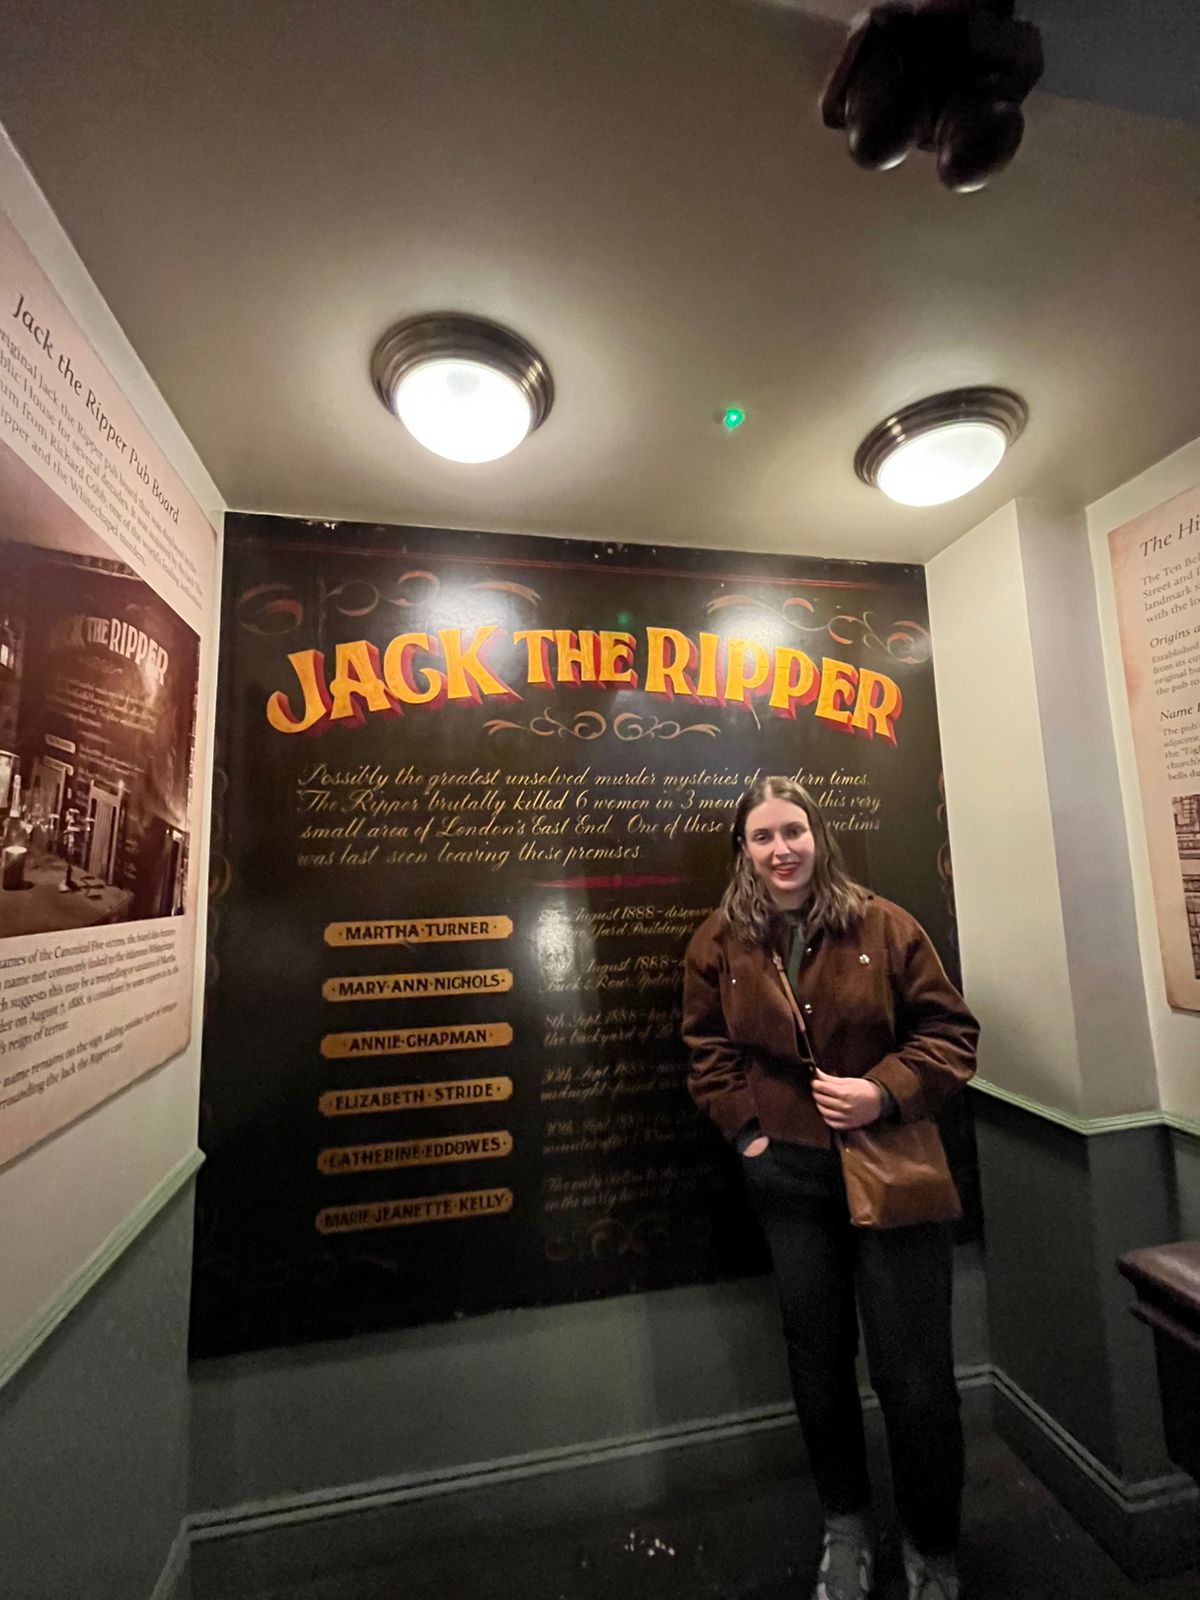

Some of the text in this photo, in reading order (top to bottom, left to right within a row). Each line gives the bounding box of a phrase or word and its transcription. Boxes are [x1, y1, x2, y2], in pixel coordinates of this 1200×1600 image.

[13, 292, 180, 525] Jack the Ripper Pub Board
[23, 378, 56, 426] House
[57, 420, 72, 444] for
[39, 374, 59, 406] Jack
[60, 402, 75, 427] the
[22, 401, 48, 440] from
[50, 432, 84, 480] Richard
[32, 440, 52, 467] and
[53, 460, 70, 485] the
[70, 476, 119, 538] Whitechapel
[1140, 534, 1173, 557] The
[1142, 572, 1161, 586] The
[1163, 562, 1183, 577] Ten
[1142, 569, 1194, 599] Street and
[1144, 585, 1193, 612] landmark
[1146, 600, 1188, 623] with the
[87, 616, 110, 645] THE
[109, 617, 169, 687] RIPPER
[1150, 627, 1191, 649] Origins
[1151, 641, 1200, 664] Established
[1153, 662, 1174, 675] from
[1155, 668, 1187, 686] original
[267, 624, 516, 734] JACK
[514, 629, 639, 690] THE
[645, 626, 902, 746] RIPPER
[1156, 686, 1170, 696] the
[1172, 681, 1189, 695] pub
[1160, 704, 1194, 722] Name
[1162, 726, 1178, 738] The
[1165, 749, 1179, 760] the
[298, 763, 389, 790] Possibly
[395, 764, 422, 785] the
[428, 767, 501, 791] greatest
[505, 766, 589, 786] unsolved
[594, 766, 656, 786] murder
[663, 767, 738, 791] mysteries
[744, 769, 763, 790] of
[790, 767, 824, 786] dern
[1167, 772, 1188, 782] bells
[297, 789, 881, 822] The Ripper brutally killed 6 women in 3 mont this very
[299, 816, 366, 839] small
[368, 825, 409, 839] area
[413, 817, 435, 843] of
[435, 815, 525, 839] London's
[531, 815, 570, 835] East
[627, 813, 659, 834] One
[663, 814, 682, 841] of
[684, 813, 724, 833] these
[297, 852, 334, 866] was
[340, 843, 380, 865] last
[386, 851, 428, 865] seen
[437, 841, 510, 871] leaving
[518, 840, 562, 862] these
[575, 906, 624, 922] August
[345, 921, 490, 940] MARTHA TURNER
[628, 920, 695, 941] Buildings
[28, 948, 39, 964] of
[39, 947, 54, 962] the
[54, 943, 91, 959] Canonical
[91, 939, 106, 952] Five
[4, 975, 31, 990] name
[31, 970, 47, 983] not
[48, 960, 87, 980] commonly
[115, 951, 126, 963] the
[10, 989, 48, 1010] suggests
[48, 982, 65, 998] this
[65, 980, 80, 994] may
[81, 976, 90, 988] be
[339, 974, 501, 996] MARY ANN NICHOLS
[15, 1015, 28, 1029] on
[29, 1004, 59, 1024] August
[7, 1034, 33, 1053] reign
[33, 1024, 46, 1043] of
[350, 1028, 488, 1052] ANNIE CHAPMAN
[543, 1030, 567, 1047] the
[569, 1026, 638, 1049] backyard
[4, 1070, 32, 1088] name
[31, 1051, 65, 1076] remains
[65, 1046, 77, 1060] on
[76, 1040, 89, 1056] the
[46, 1070, 62, 1088] the
[61, 1061, 77, 1080] Jack
[77, 1057, 90, 1073] the
[90, 1046, 112, 1066] Ripper
[336, 1082, 495, 1111] ELIZABETH STRIDE
[329, 1136, 501, 1169] CATHERINE EDDOWES
[324, 1192, 506, 1229] MARIE JEANETTE KELLY
